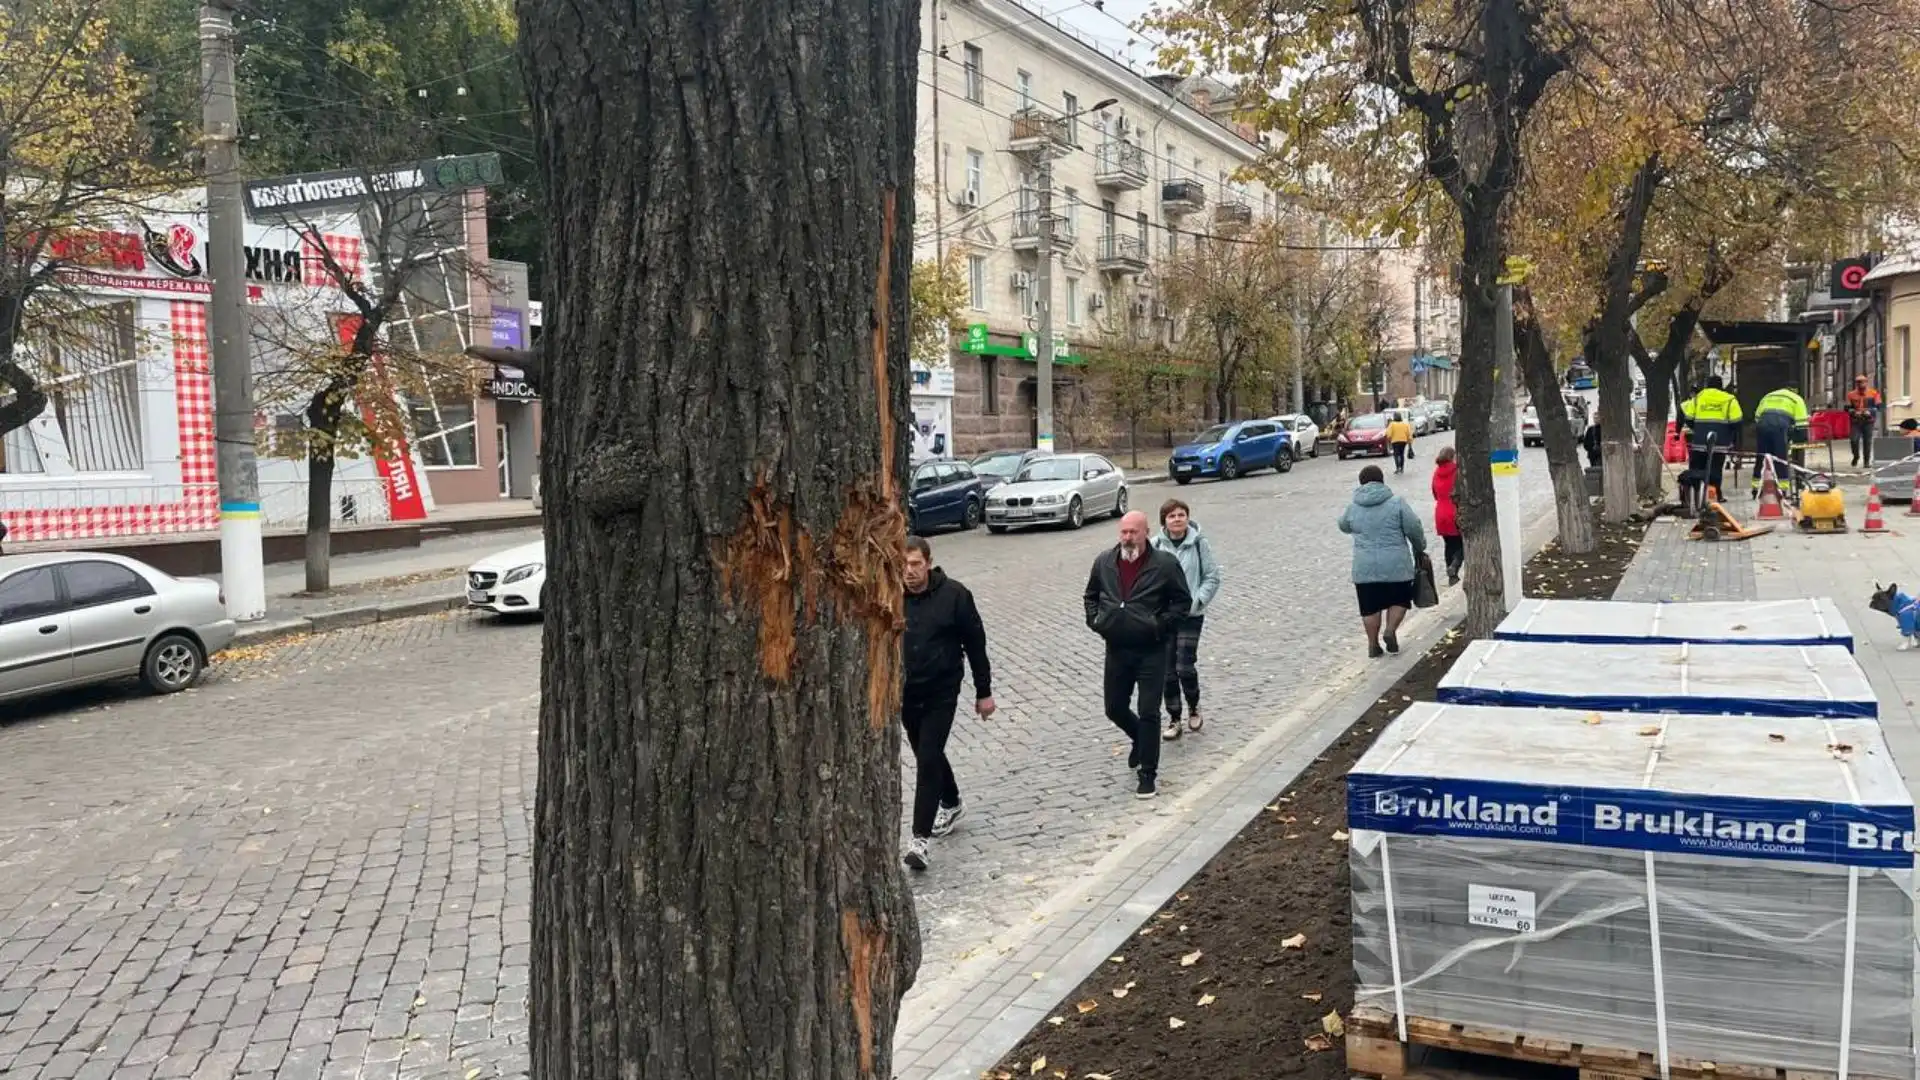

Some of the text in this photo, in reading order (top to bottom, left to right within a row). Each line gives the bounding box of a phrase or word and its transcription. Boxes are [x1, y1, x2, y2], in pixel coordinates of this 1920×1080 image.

[204, 242, 301, 283] ХНЯ
[147, 279, 192, 293] МЕРЕЖА
[1374, 791, 1558, 827] Brukland
[1448, 820, 1558, 835] www.brukland.com.ua
[1593, 803, 1806, 844] Brukland
[1679, 837, 1806, 854] www.brukland.com.ua
[1486, 905, 1519, 918] ГРАФІТ
[1513, 920, 1531, 931] 60
